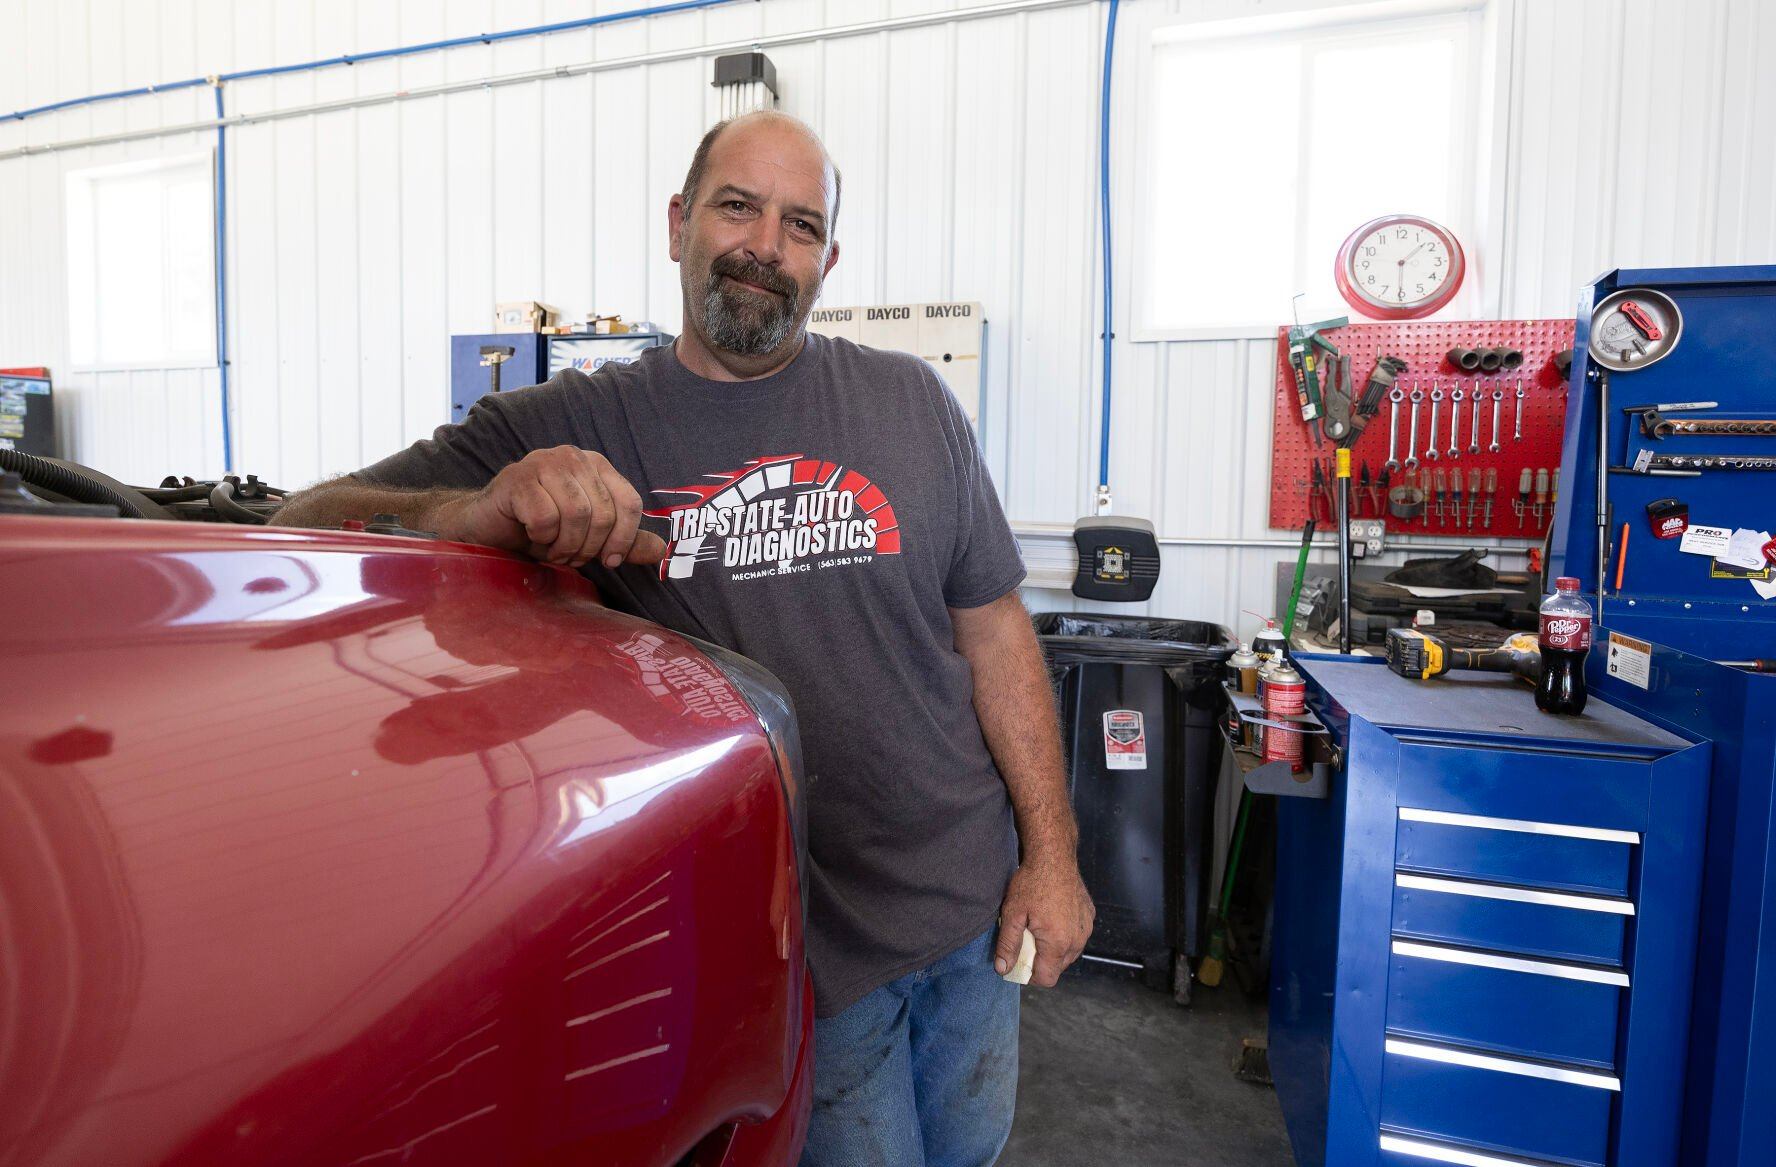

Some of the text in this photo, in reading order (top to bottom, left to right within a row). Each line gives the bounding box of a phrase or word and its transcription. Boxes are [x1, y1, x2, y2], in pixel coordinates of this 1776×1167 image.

[1379, 234, 1386, 245] 11
[1396, 229, 1408, 239] 12
[1365, 246, 1376, 257] 10
[1426, 241, 1436, 252] 2
[1361, 260, 1370, 270] 9
[1433, 257, 1442, 267] 3
[1367, 274, 1376, 285] 8
[1427, 271, 1437, 281] 4
[1380, 285, 1390, 295] 7
[1415, 283, 1424, 293] 5
[811, 309, 854, 323] DAYCO
[867, 306, 910, 321] DAYCO
[925, 304, 971, 319] DAYCO
[671, 489, 854, 542] TRI-STATE AUTO
[1695, 528, 1722, 537] PRO
[724, 518, 878, 568] DIAGNOSTICS
[731, 568, 776, 582] MECHANIC
[777, 563, 811, 575] SERVICE
[1550, 620, 1579, 635] Pepper
